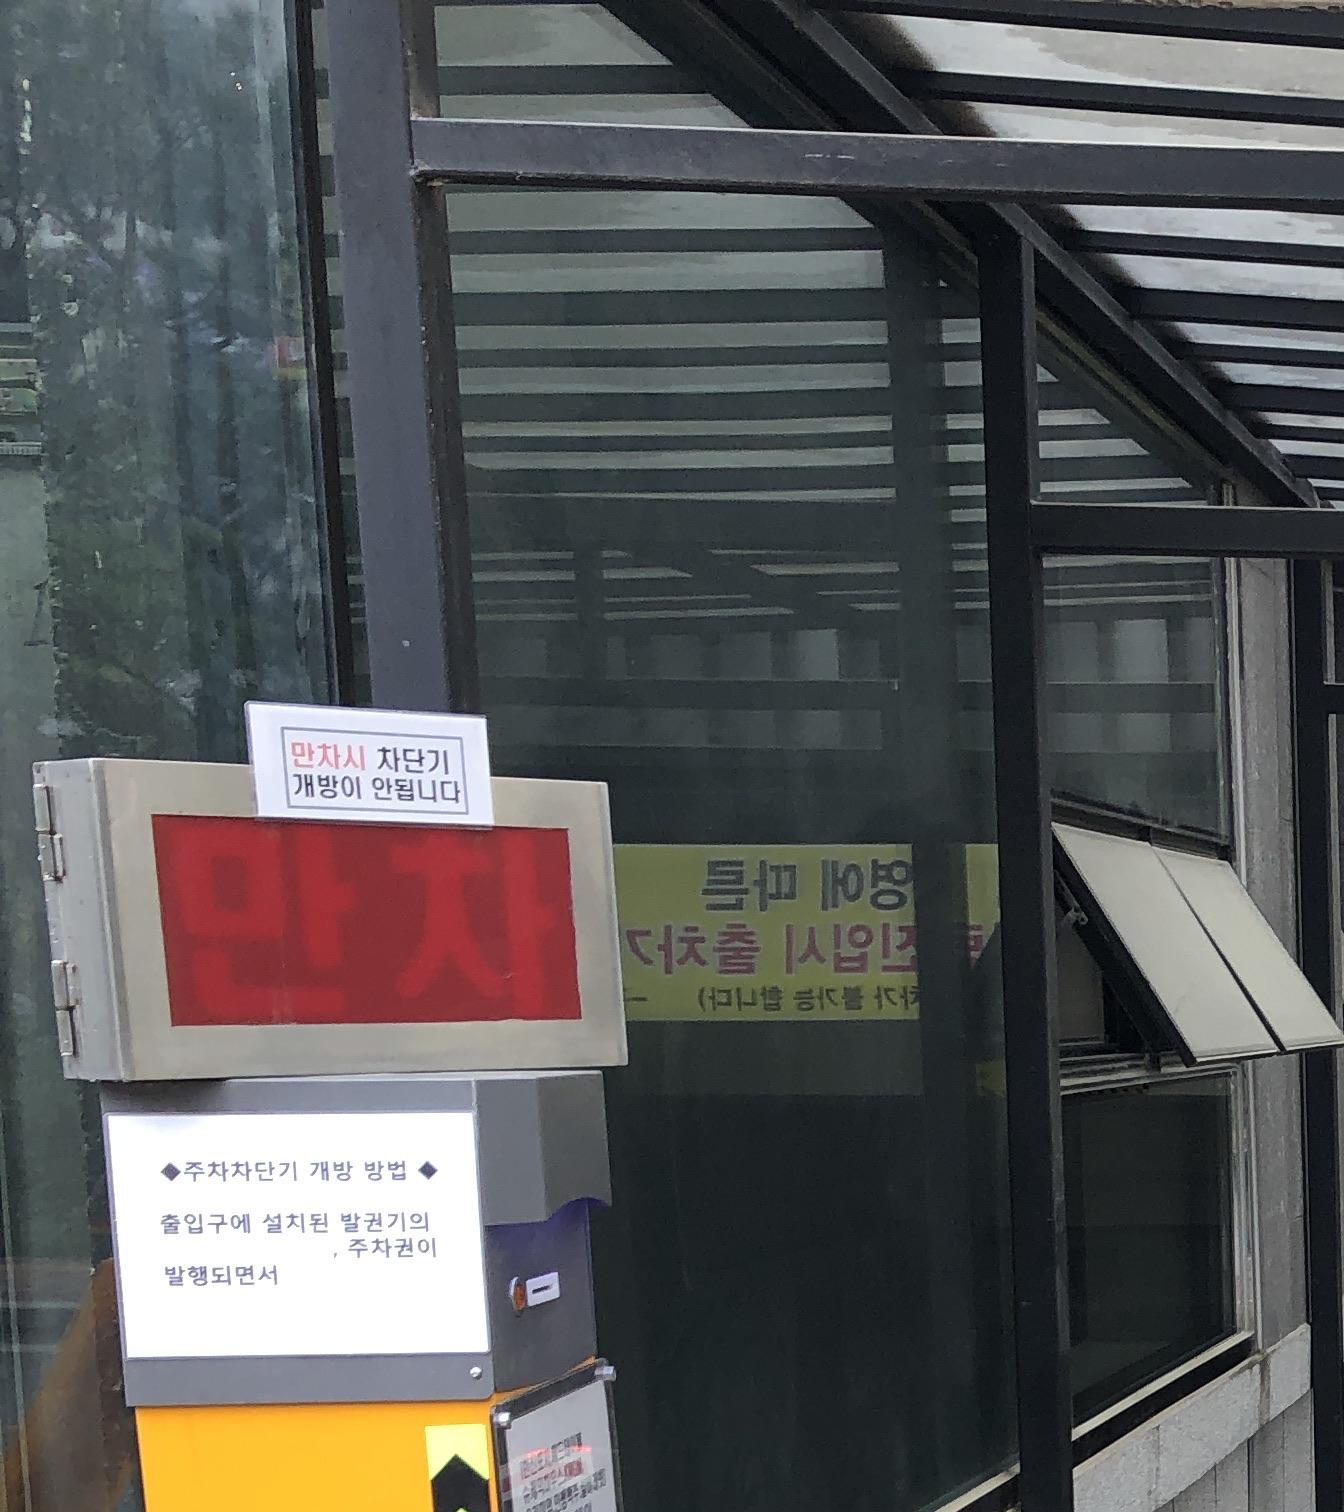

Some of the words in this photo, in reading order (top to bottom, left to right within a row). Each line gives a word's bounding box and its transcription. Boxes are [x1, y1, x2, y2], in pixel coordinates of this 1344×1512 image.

[290, 741, 366, 772] 만차시
[377, 745, 450, 775] 차단기
[293, 773, 362, 800] 개방이
[371, 776, 461, 804] 안됩니다
[171, 827, 556, 1016] 만차
[183, 1160, 298, 1182] 주차차단기
[310, 1160, 353, 1181] 개방
[364, 1160, 408, 1181] 방법
[160, 1212, 251, 1235] 출입구에
[262, 1212, 329, 1234] 설치된
[340, 1211, 430, 1233] 발권기의
[348, 1236, 437, 1259] 주차권이
[164, 1265, 279, 1287] 발행되면서
